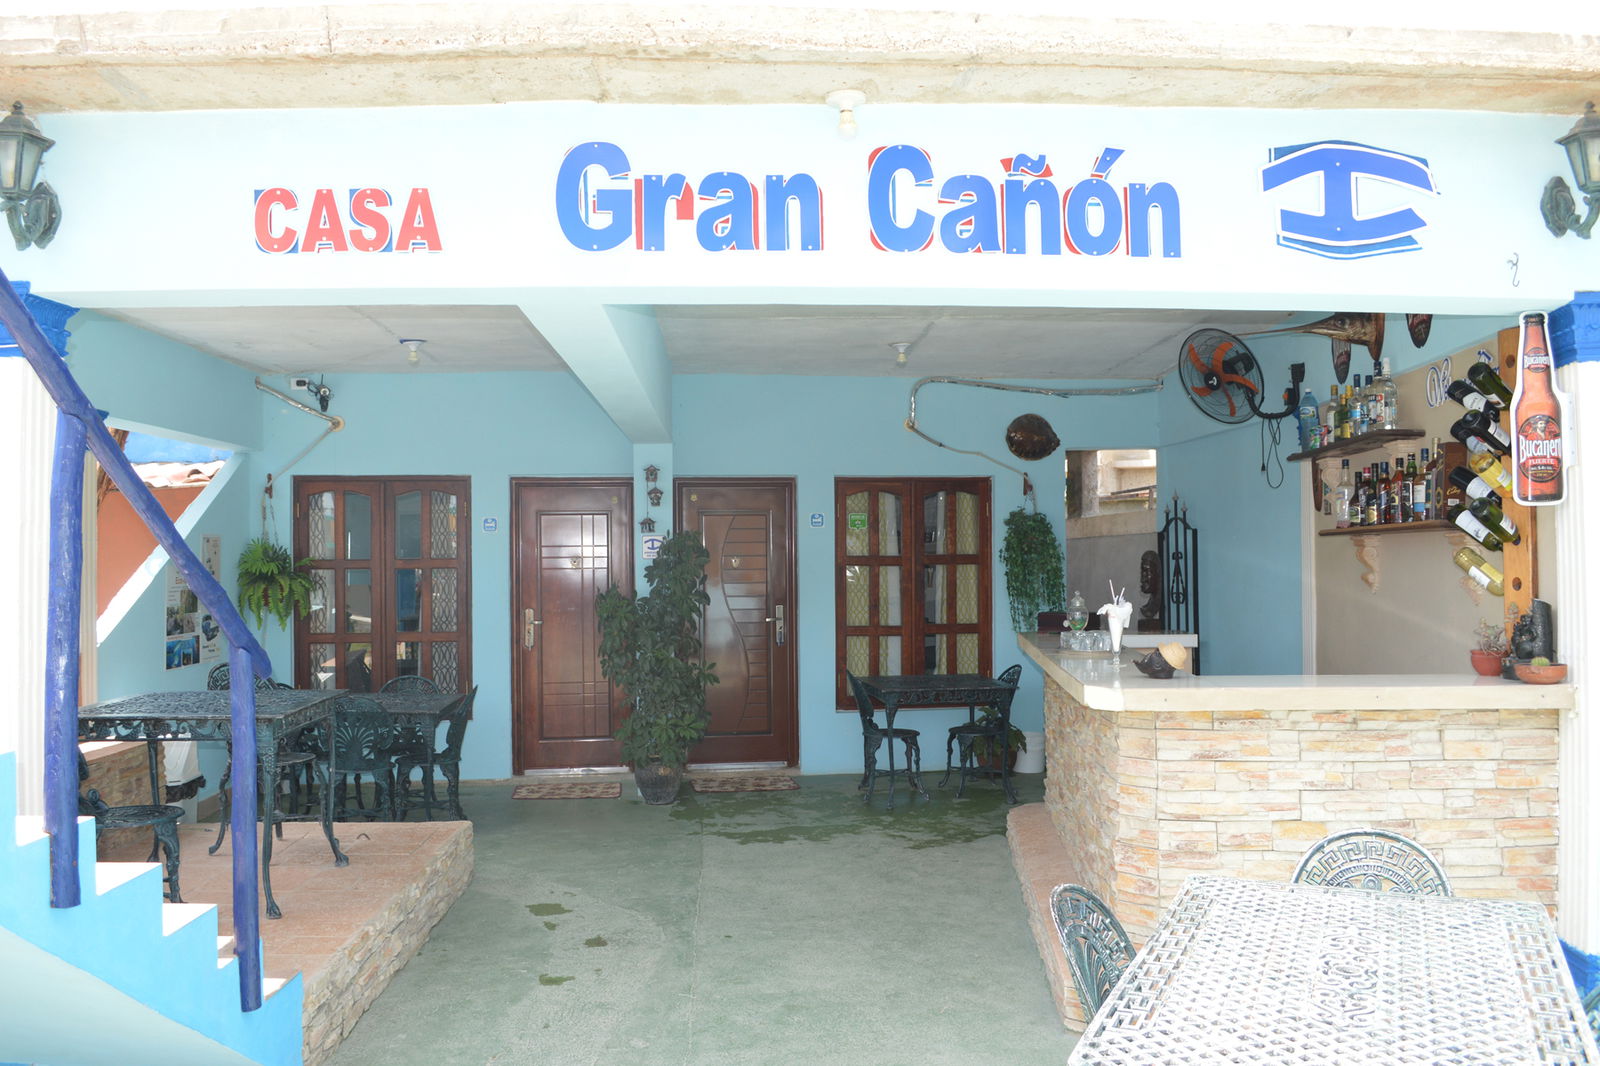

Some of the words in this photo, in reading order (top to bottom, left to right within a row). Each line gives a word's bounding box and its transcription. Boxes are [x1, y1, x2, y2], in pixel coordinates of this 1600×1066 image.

[254, 187, 442, 253] CASA
[555, 141, 824, 251] Gran
[867, 144, 1182, 258] Cañón
